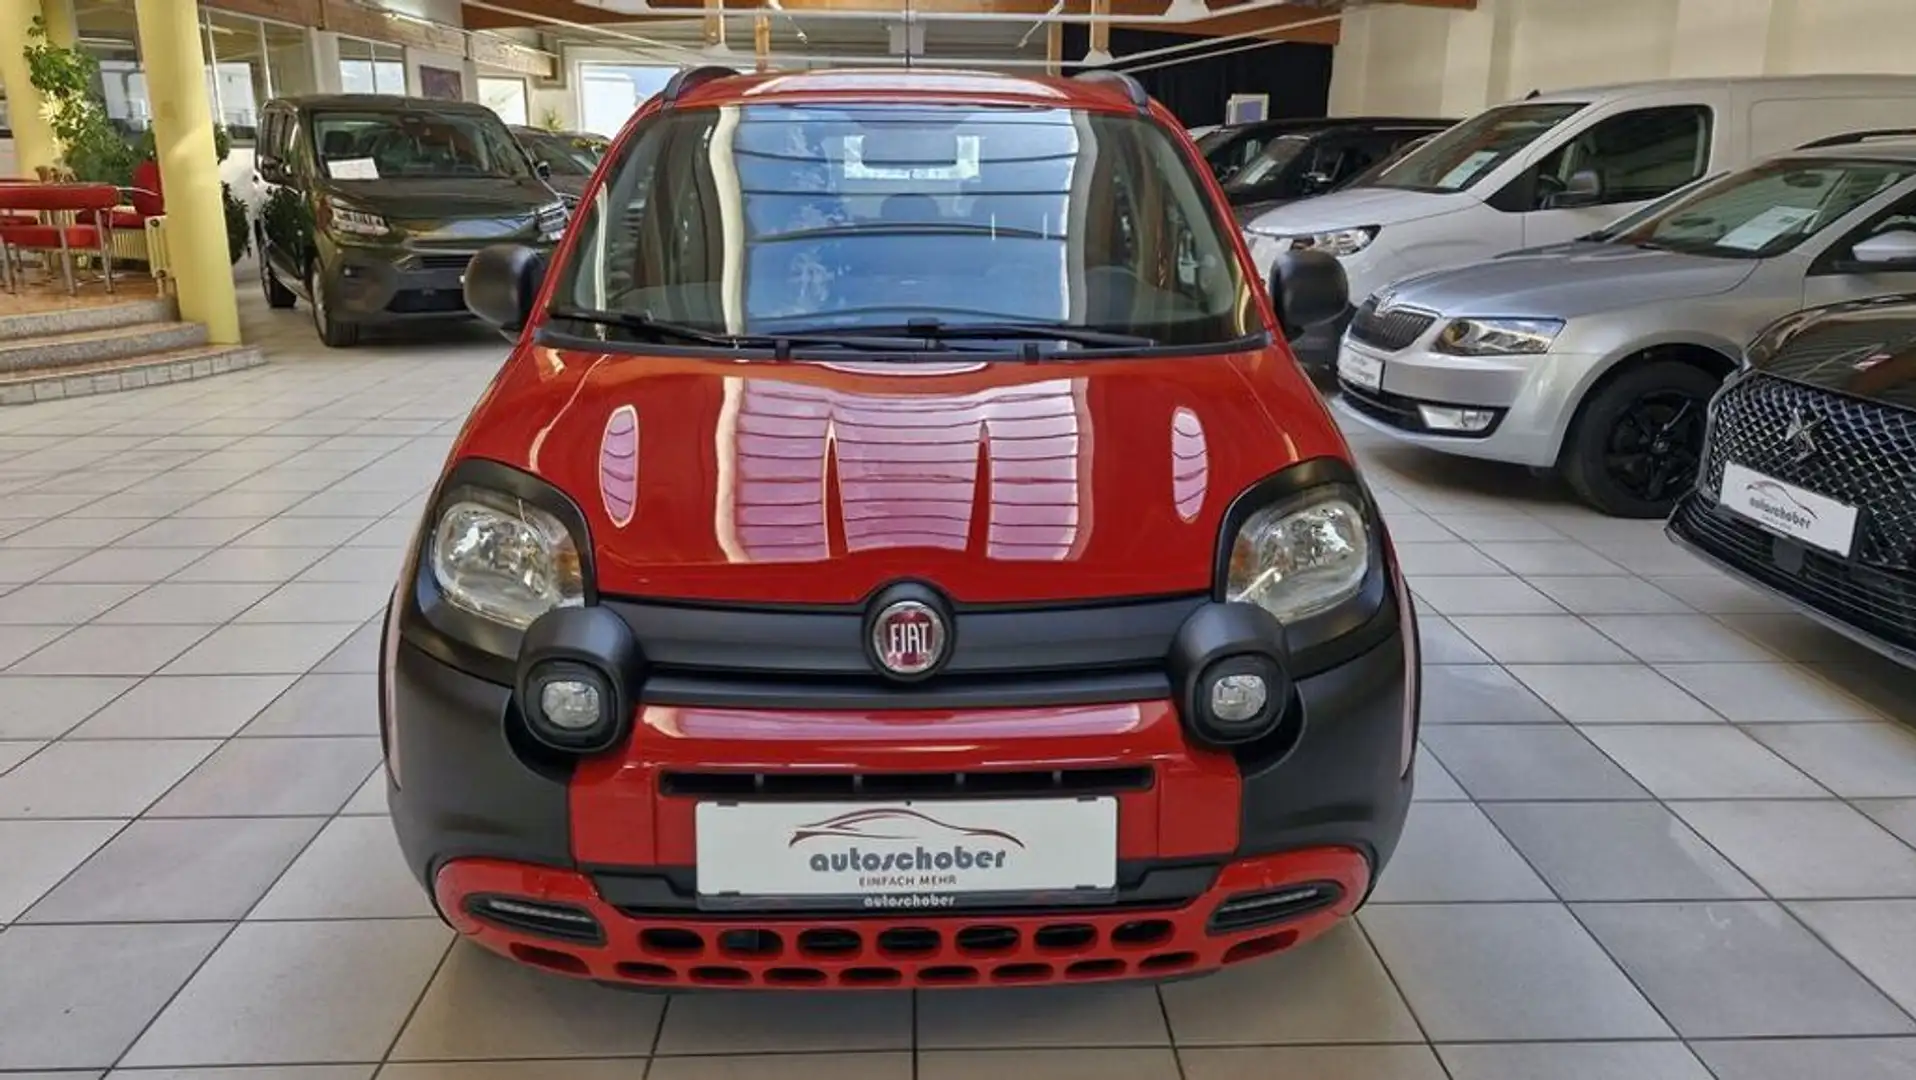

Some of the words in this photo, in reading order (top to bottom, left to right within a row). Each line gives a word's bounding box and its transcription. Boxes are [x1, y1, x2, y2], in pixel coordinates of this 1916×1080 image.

[890, 622, 930, 654] FIAT
[809, 846, 1006, 872] autoschober
[859, 876, 915, 887] EINFACH
[919, 875, 957, 885] MEHR
[863, 894, 956, 908] autoschober
